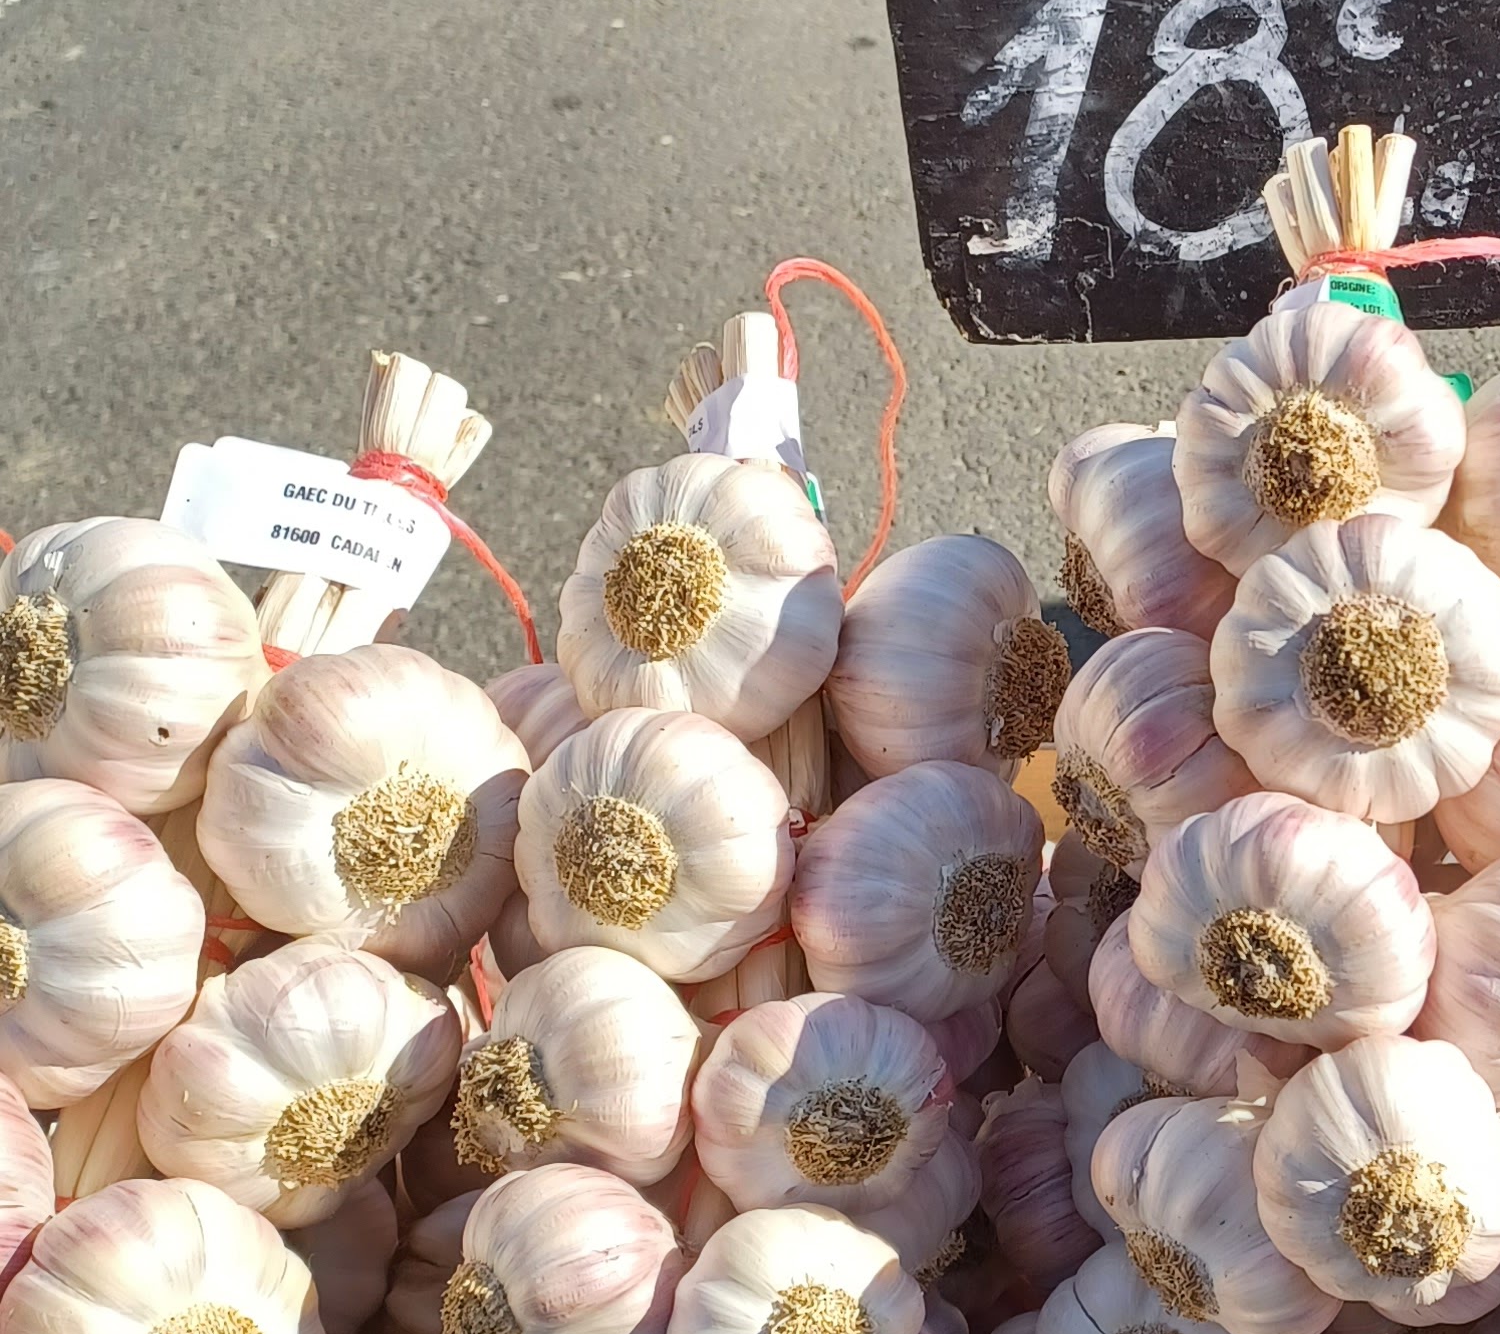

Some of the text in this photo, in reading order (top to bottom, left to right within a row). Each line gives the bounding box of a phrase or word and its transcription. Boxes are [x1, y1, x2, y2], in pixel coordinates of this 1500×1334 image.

[283, 482, 329, 504] GAEC
[331, 493, 357, 511] DU
[270, 523, 321, 546] 81600
